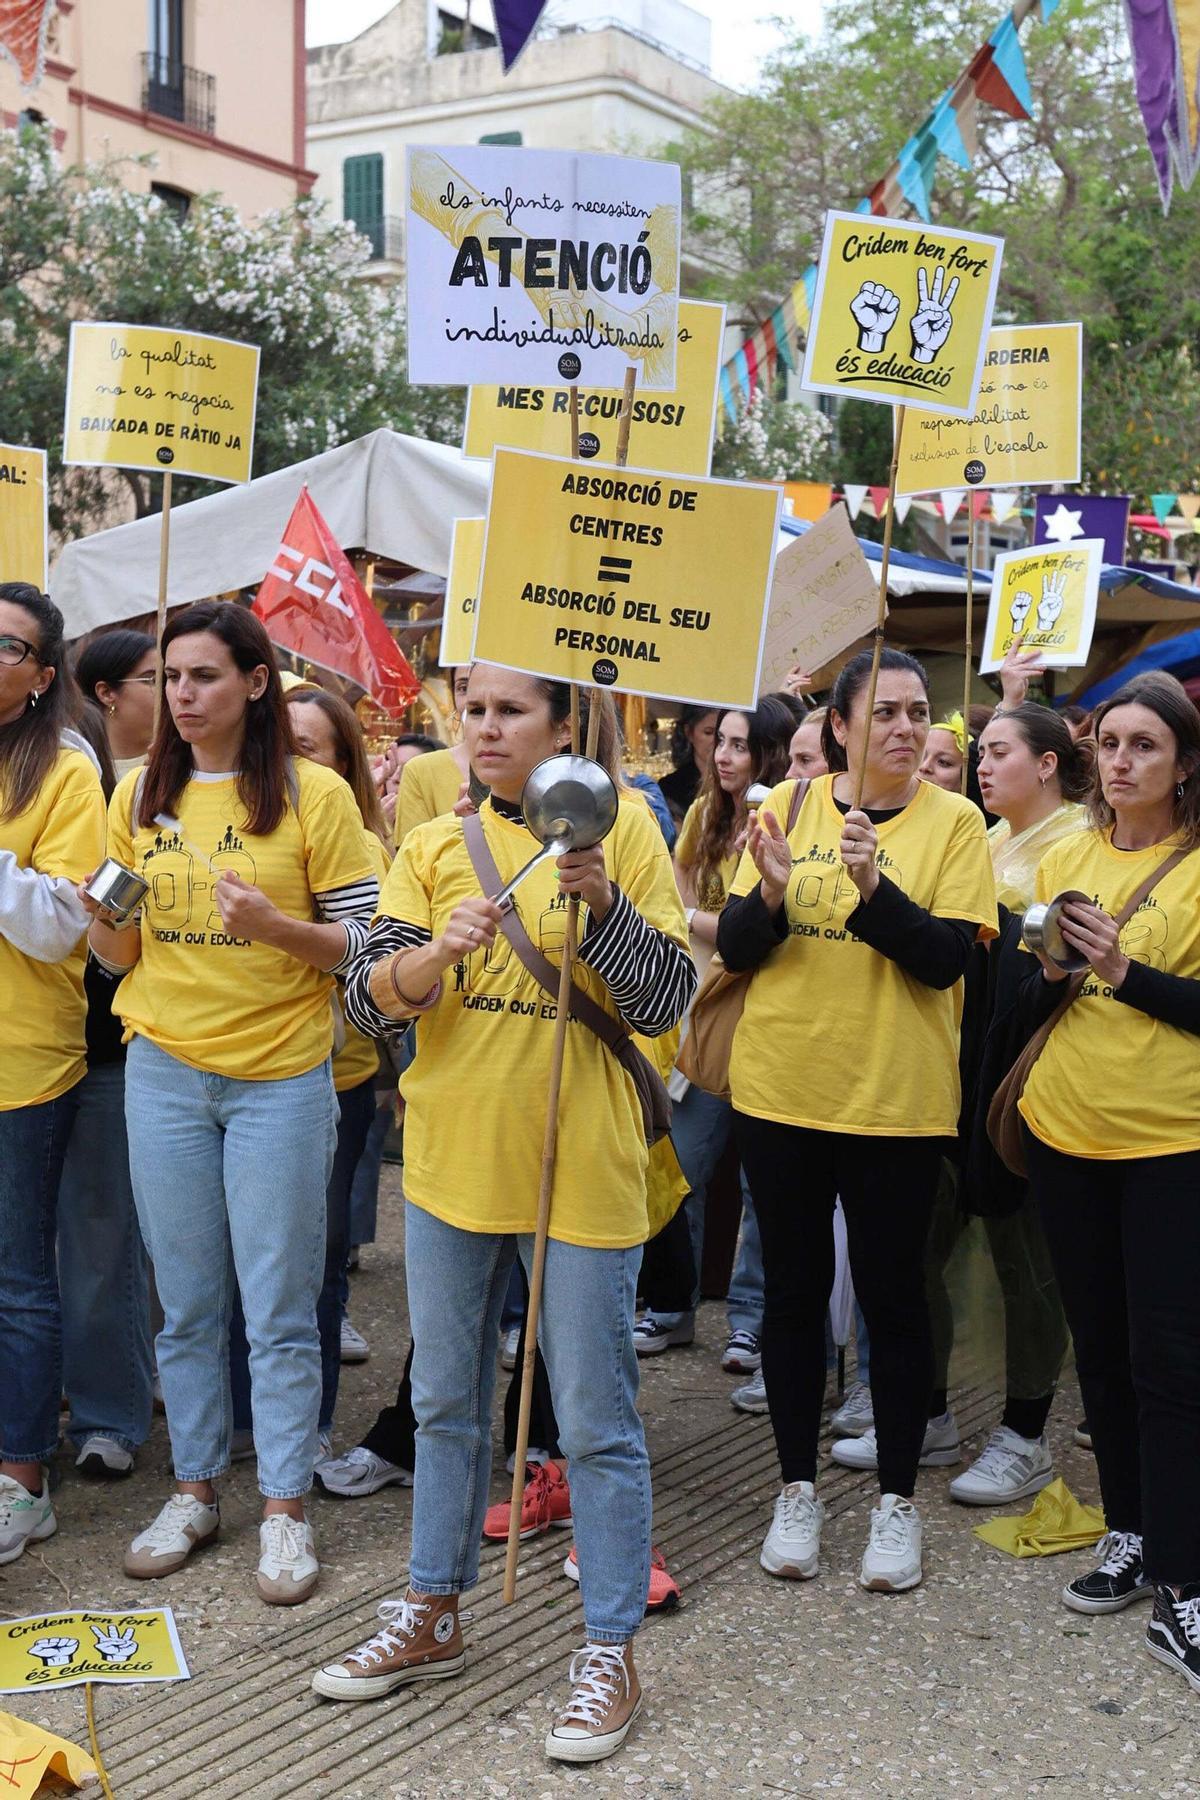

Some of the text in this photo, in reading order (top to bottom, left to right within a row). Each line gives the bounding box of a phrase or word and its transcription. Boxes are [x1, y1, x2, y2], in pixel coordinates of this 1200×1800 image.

[440, 182, 652, 226] els infants necessiten
[448, 231, 650, 295] ATENCIÓ
[914, 234, 946, 260] ben
[947, 246, 988, 278] fort
[111, 338, 216, 375] la qualitat
[560, 360, 578, 368] SOM
[836, 348, 861, 373] és
[866, 352, 955, 387] educació
[984, 347, 1050, 366] RDERIA
[96, 384, 126, 396] no
[165, 391, 234, 415] negocia
[1033, 378, 1048, 390] és
[80, 417, 242, 450] BAIXADA DE RÀTIO JA
[920, 404, 1030, 440] responsabilitat
[578, 438, 598, 448] SOM
[966, 438, 980, 455] de
[984, 432, 1048, 455] l'escola
[966, 466, 984, 474] SOM
[561, 474, 698, 512] ABSORCIÓ DE
[569, 514, 664, 546] CENTRES
[1042, 556, 1058, 568] ben
[1060, 555, 1086, 572] fort
[520, 582, 711, 631] ABSORCIÓ DEL SEU
[554, 628, 661, 663] PERSONAL
[1002, 635, 1013, 650] és
[596, 664, 616, 676] SOM
[82, 1614, 114, 1624] ben
[118, 1616, 160, 1627] fort
[25, 1660, 154, 1682] és educació
